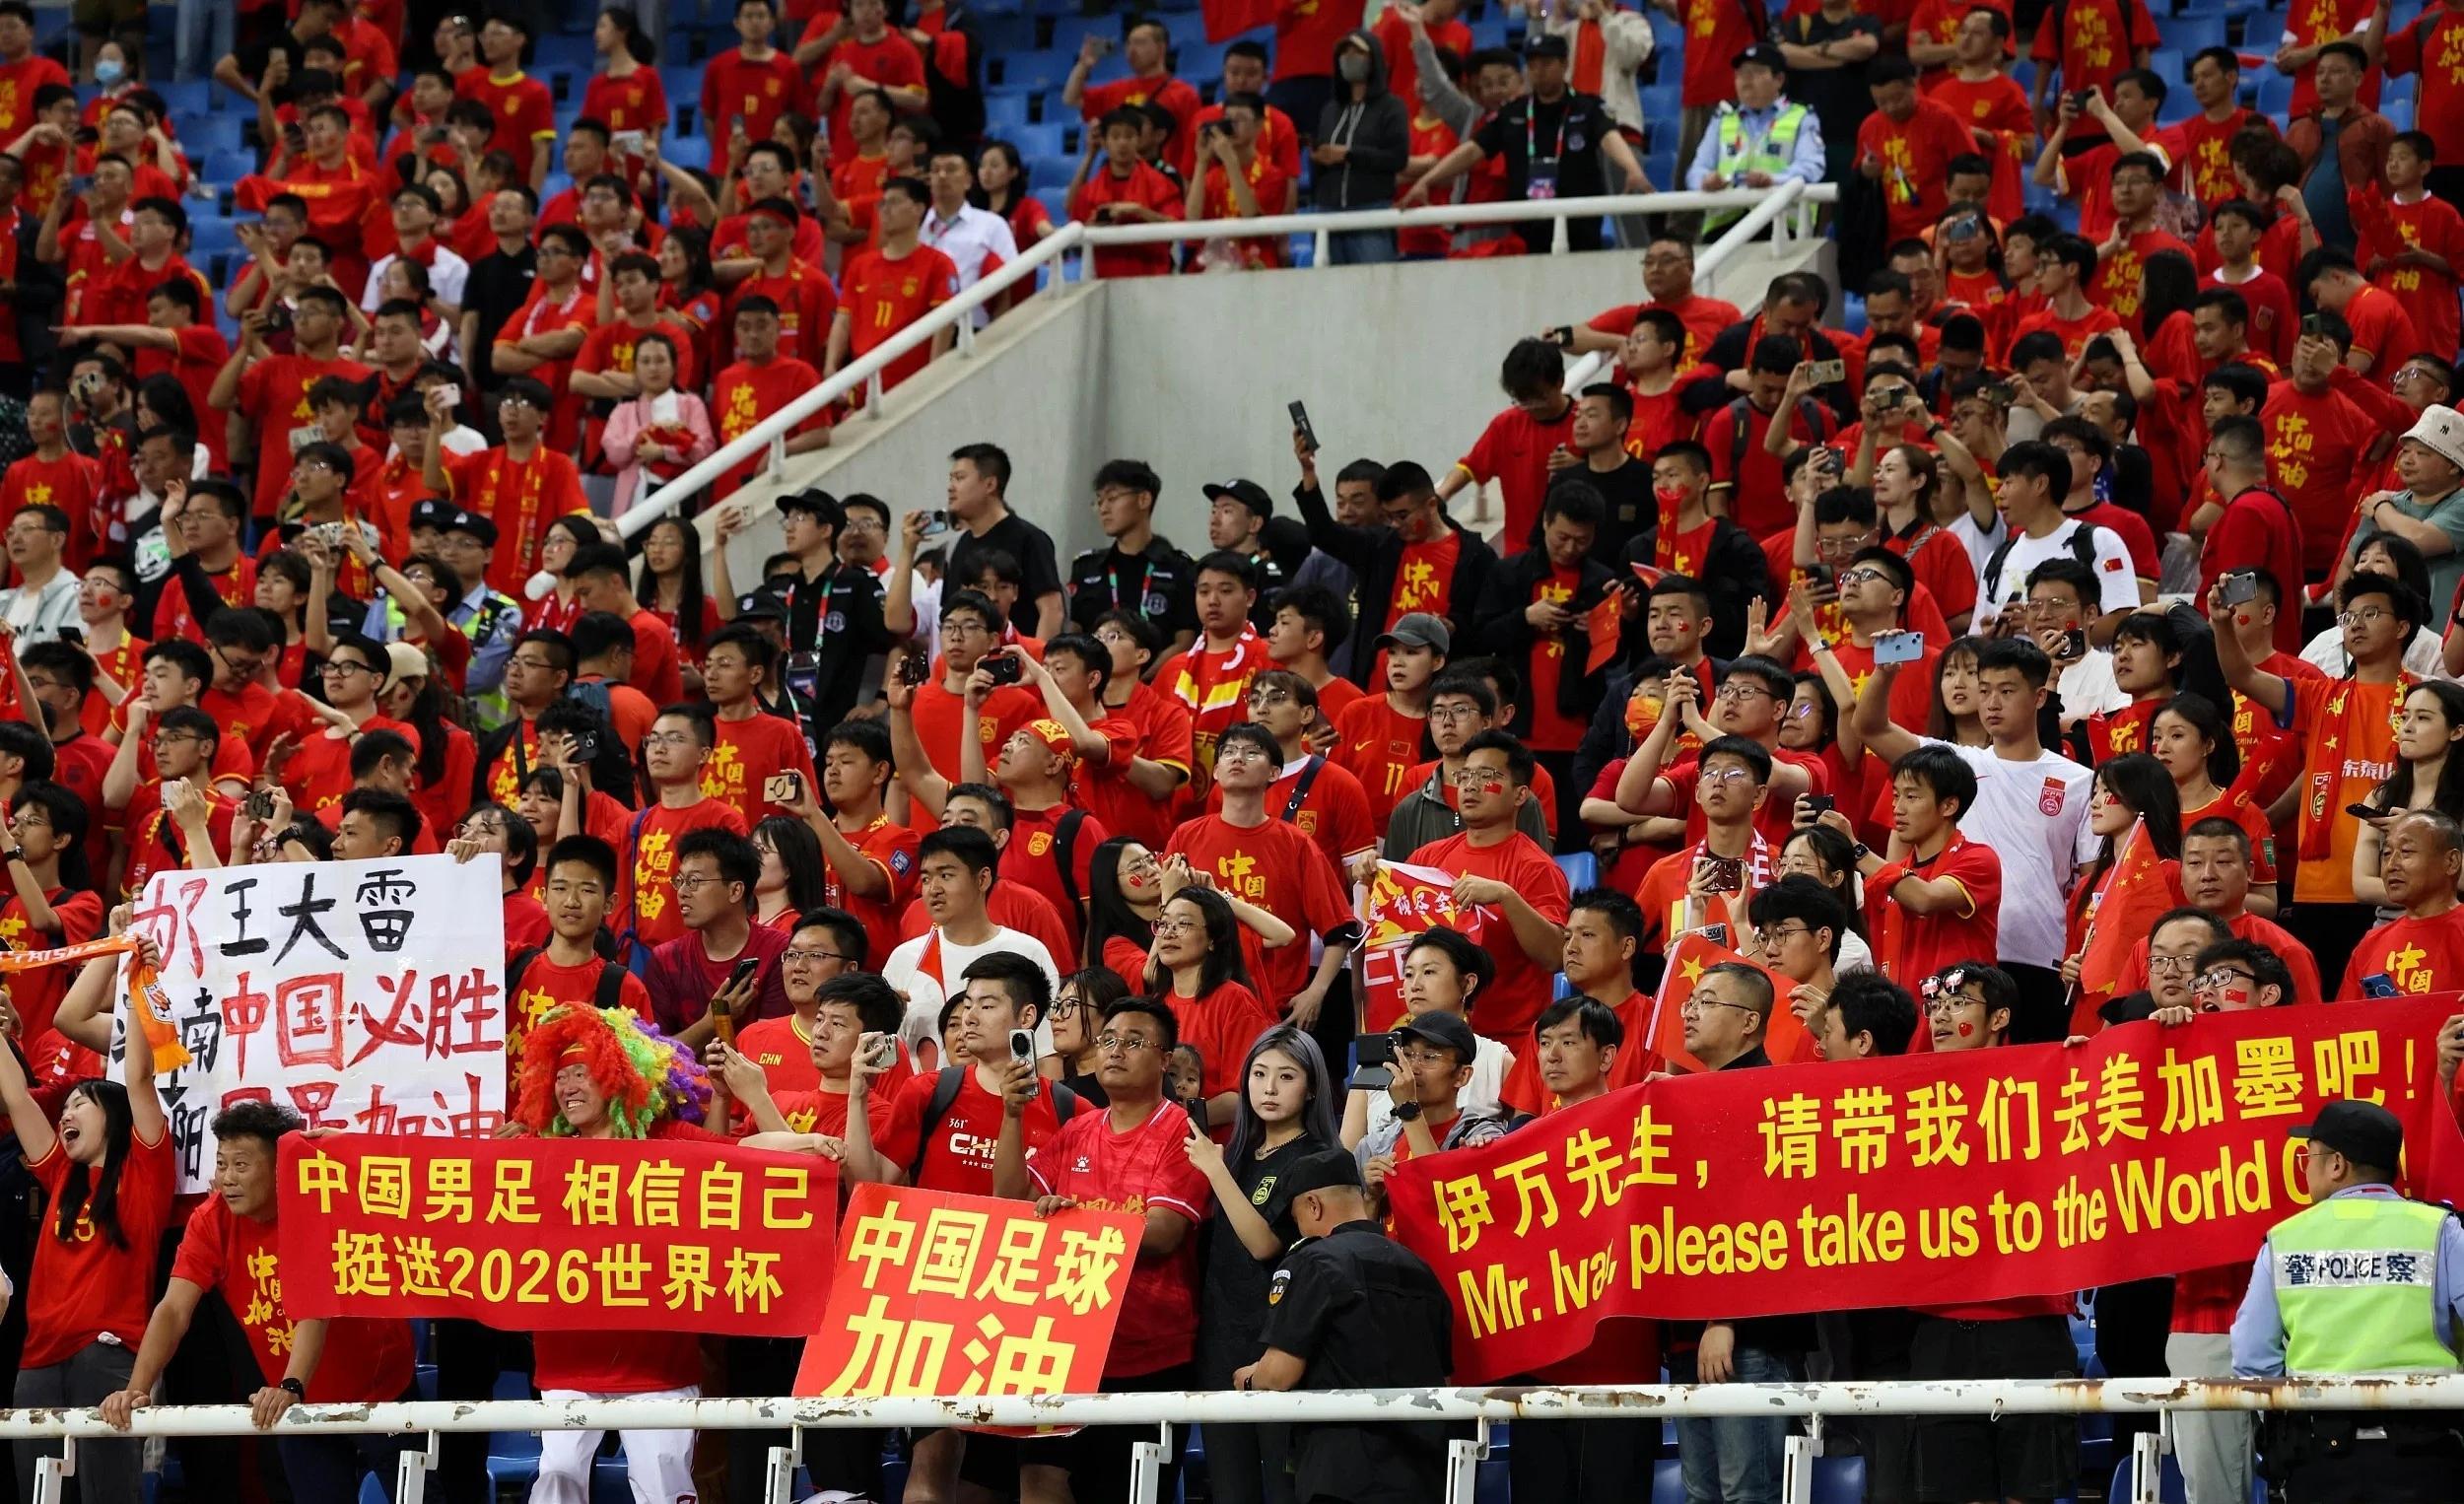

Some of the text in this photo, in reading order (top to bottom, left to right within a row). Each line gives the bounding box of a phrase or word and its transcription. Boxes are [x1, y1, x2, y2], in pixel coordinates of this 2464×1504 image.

[875, 300, 892, 328] 11
[641, 828, 672, 871] 中国
[1218, 849, 1266, 899] 中国
[2386, 941, 2433, 993] 中国
[221, 968, 505, 1081] 中国必胜
[759, 1053, 783, 1065] CHN
[221, 1071, 505, 1140] 足加油
[298, 1149, 814, 1231] 中国男足 相信自己
[331, 1229, 784, 1314] 挺进2026世界杯
[847, 1199, 1128, 1316] 中国足球
[1457, 1264, 1542, 1339] Mr.
[1630, 1204, 1789, 1290] please
[1797, 1194, 1906, 1267] take
[1919, 1205, 1980, 1260] us
[1988, 1191, 2043, 1255] to
[2053, 1174, 2108, 1250] the
[2110, 1139, 2272, 1234] World
[2285, 1253, 2416, 1285] 警 POLICE 察
[820, 1294, 1076, 1399] 加油
